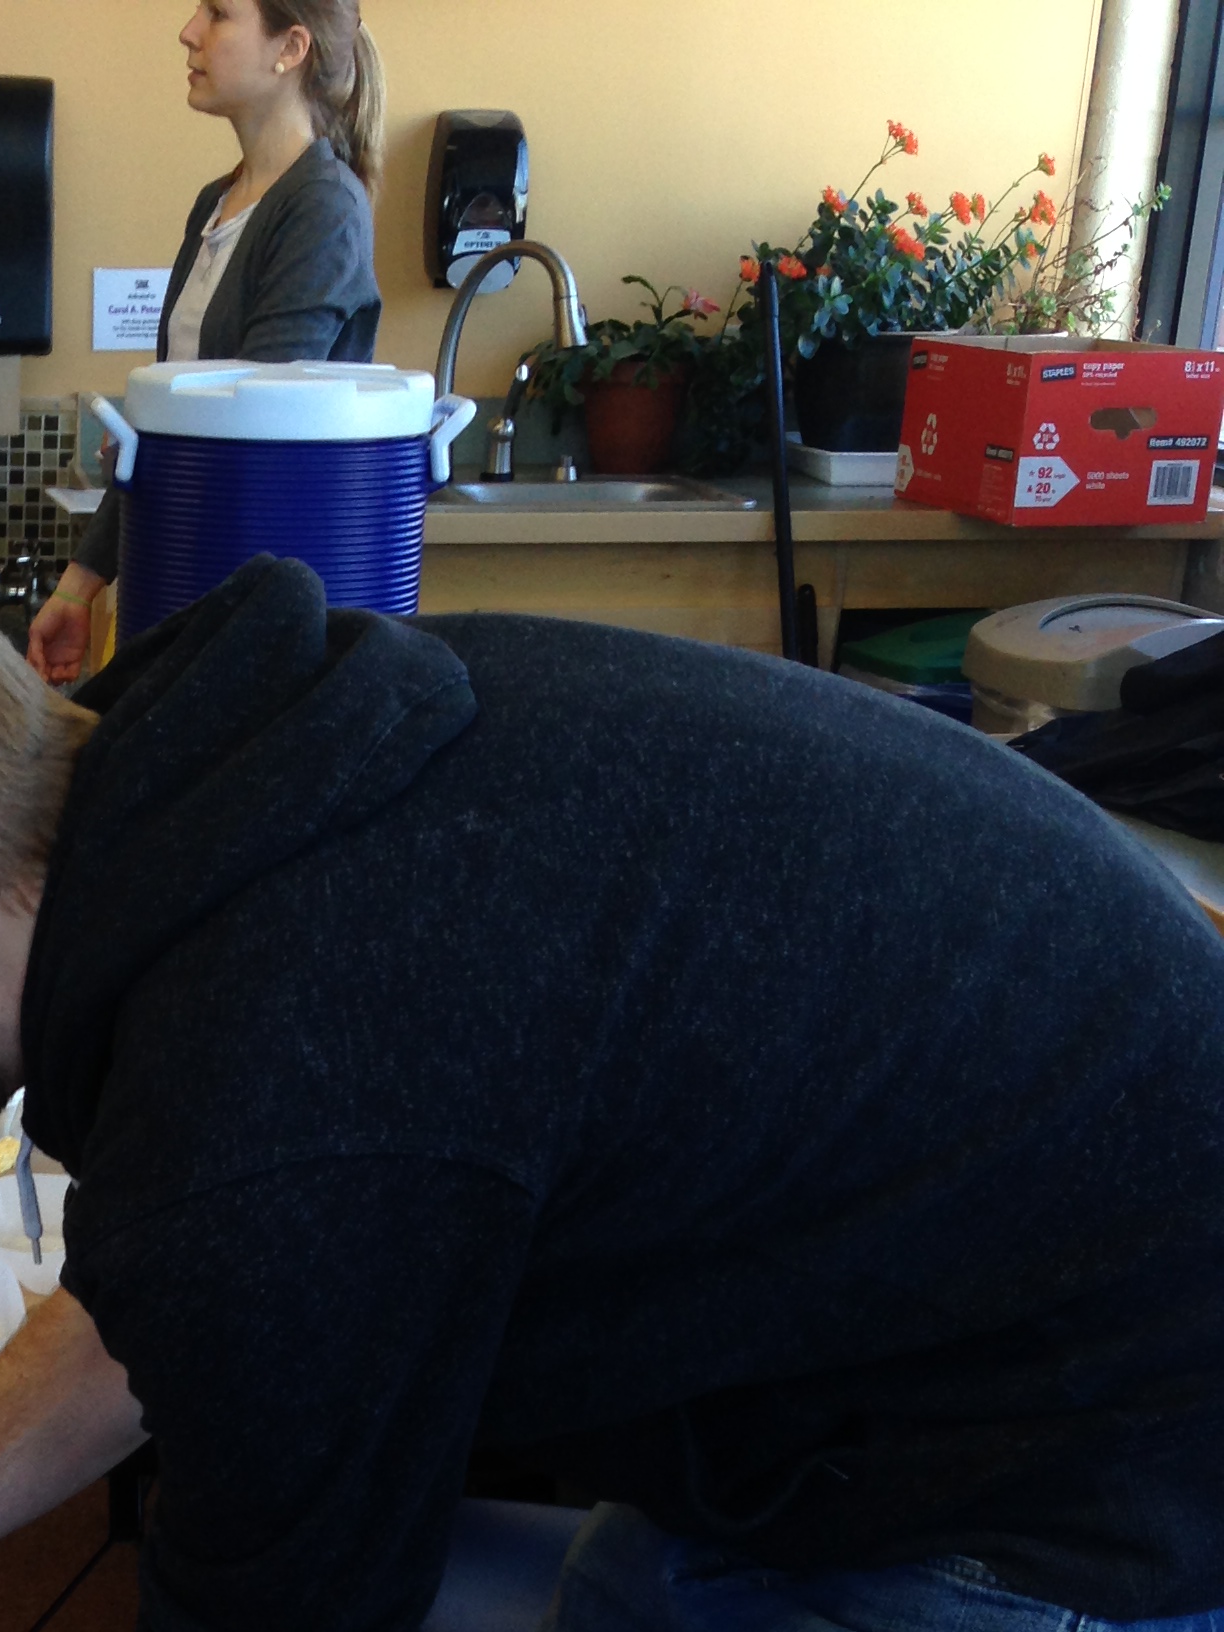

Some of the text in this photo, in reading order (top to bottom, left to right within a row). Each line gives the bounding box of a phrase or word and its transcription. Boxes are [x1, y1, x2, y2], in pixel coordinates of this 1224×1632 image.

[1042, 366, 1075, 379] STAPLES
[1103, 362, 1125, 372] paper
[1037, 466, 1053, 479] 92
[1035, 482, 1051, 494] 20
